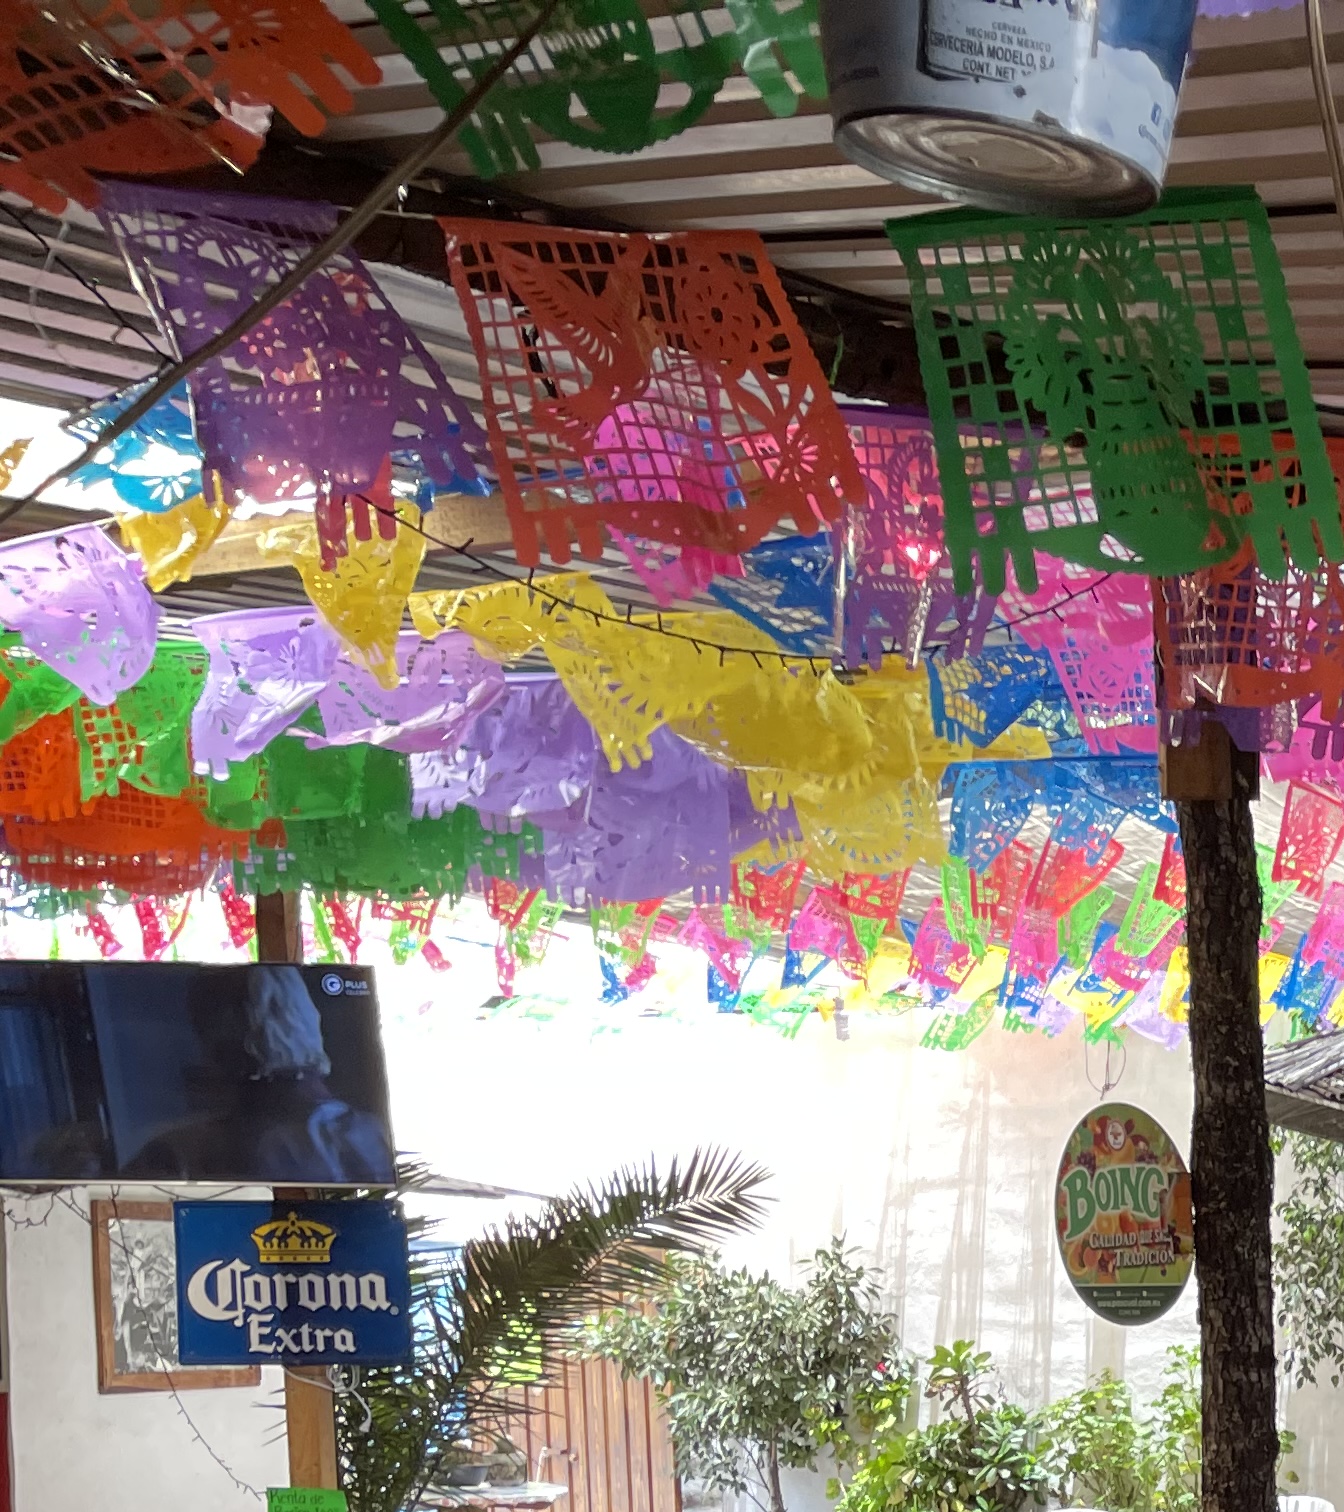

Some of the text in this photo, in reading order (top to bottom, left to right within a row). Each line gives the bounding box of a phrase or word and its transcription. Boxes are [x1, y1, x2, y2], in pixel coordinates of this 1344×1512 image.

[965, 26, 998, 41] HECHO
[1000, 33, 1014, 46] EN
[995, 64, 1016, 81] NET
[187, 1258, 392, 1328] Corona
[247, 1313, 357, 1354] Extra
[270, 1489, 307, 1504] Renta
